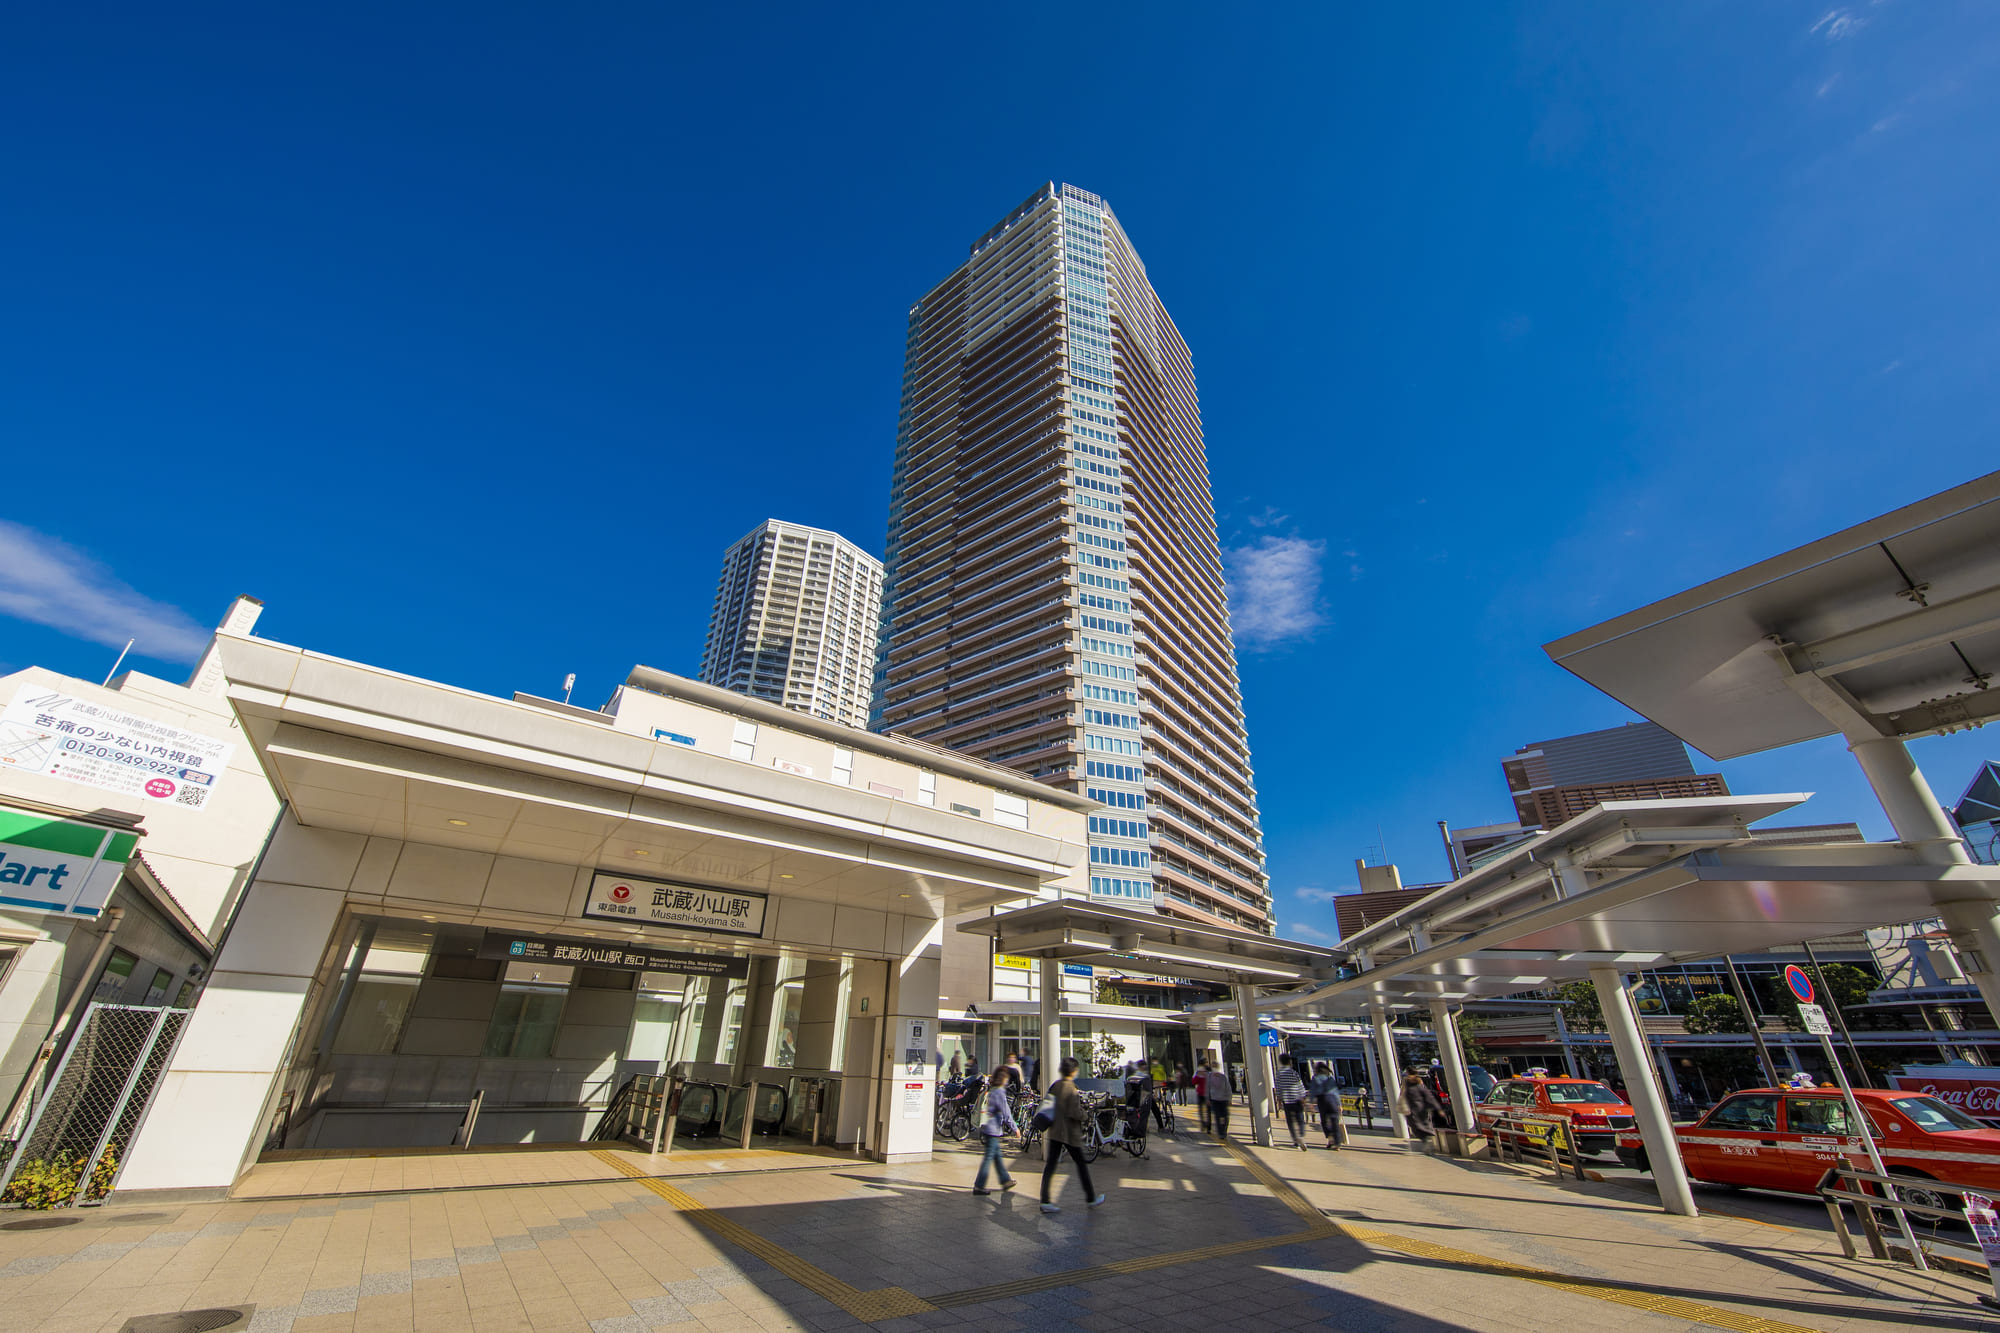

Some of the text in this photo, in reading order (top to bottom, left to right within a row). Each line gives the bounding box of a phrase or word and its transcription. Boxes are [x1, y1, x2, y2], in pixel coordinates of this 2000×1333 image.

[35, 713, 203, 767] 苦痛の少ない内視鏡
[65, 739, 178, 775] 0120-949-922
[0, 852, 70, 891] art
[597, 902, 637, 915] 東急電鉄
[651, 888, 750, 917] 武蔵小山駅
[651, 909, 747, 929] Musashi-koyama Sta.
[553, 945, 646, 966] 武蔵小山駅 西口
[1154, 975, 1193, 986] THE MALL
